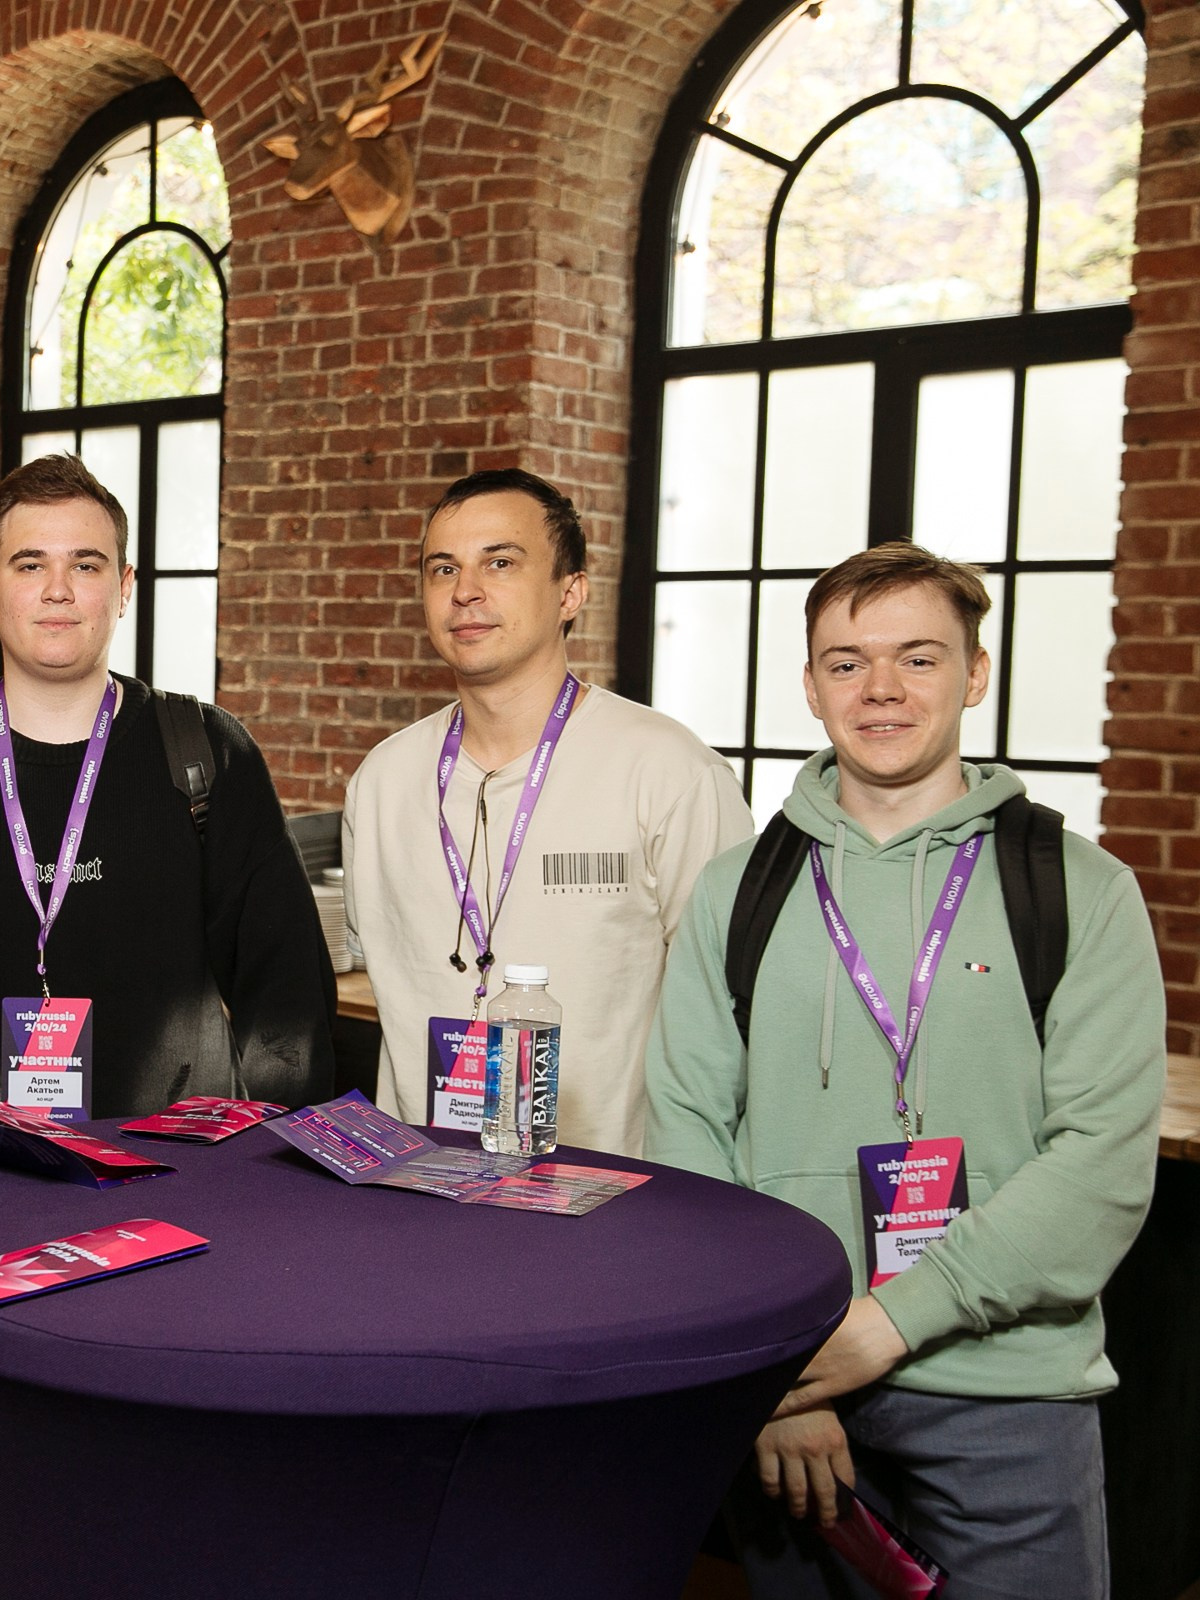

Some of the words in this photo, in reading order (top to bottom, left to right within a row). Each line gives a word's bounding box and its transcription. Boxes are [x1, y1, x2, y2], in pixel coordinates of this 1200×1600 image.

[97, 710, 110, 738] evrone
[440, 755, 453, 788] evrone
[530, 740, 551, 788] rubyrussia
[2, 757, 14, 800] rubyrussia
[79, 760, 96, 804] rubyrussia
[13, 823, 28, 855] evrone
[511, 812, 528, 846] evrone
[943, 875, 964, 911] evrone
[824, 899, 851, 948] rubyrussia
[917, 929, 942, 982] rubyrussia
[857, 973, 883, 1009] evrone
[16, 1011, 76, 1022] rubyrussia
[24, 1022, 68, 1033] 2/10/24
[442, 1031, 487, 1045] rubyrus
[451, 1043, 486, 1056] 2/10/2
[8, 1055, 83, 1068] участник
[26, 1086, 64, 1094] Акатьев
[30, 1076, 60, 1085] Артем
[532, 1036, 550, 1125] BAIKAL
[877, 1155, 949, 1172] rubyrussia
[888, 1170, 940, 1185] 2/10/24
[873, 1207, 961, 1229] участник
[897, 1247, 923, 1256] Теле
